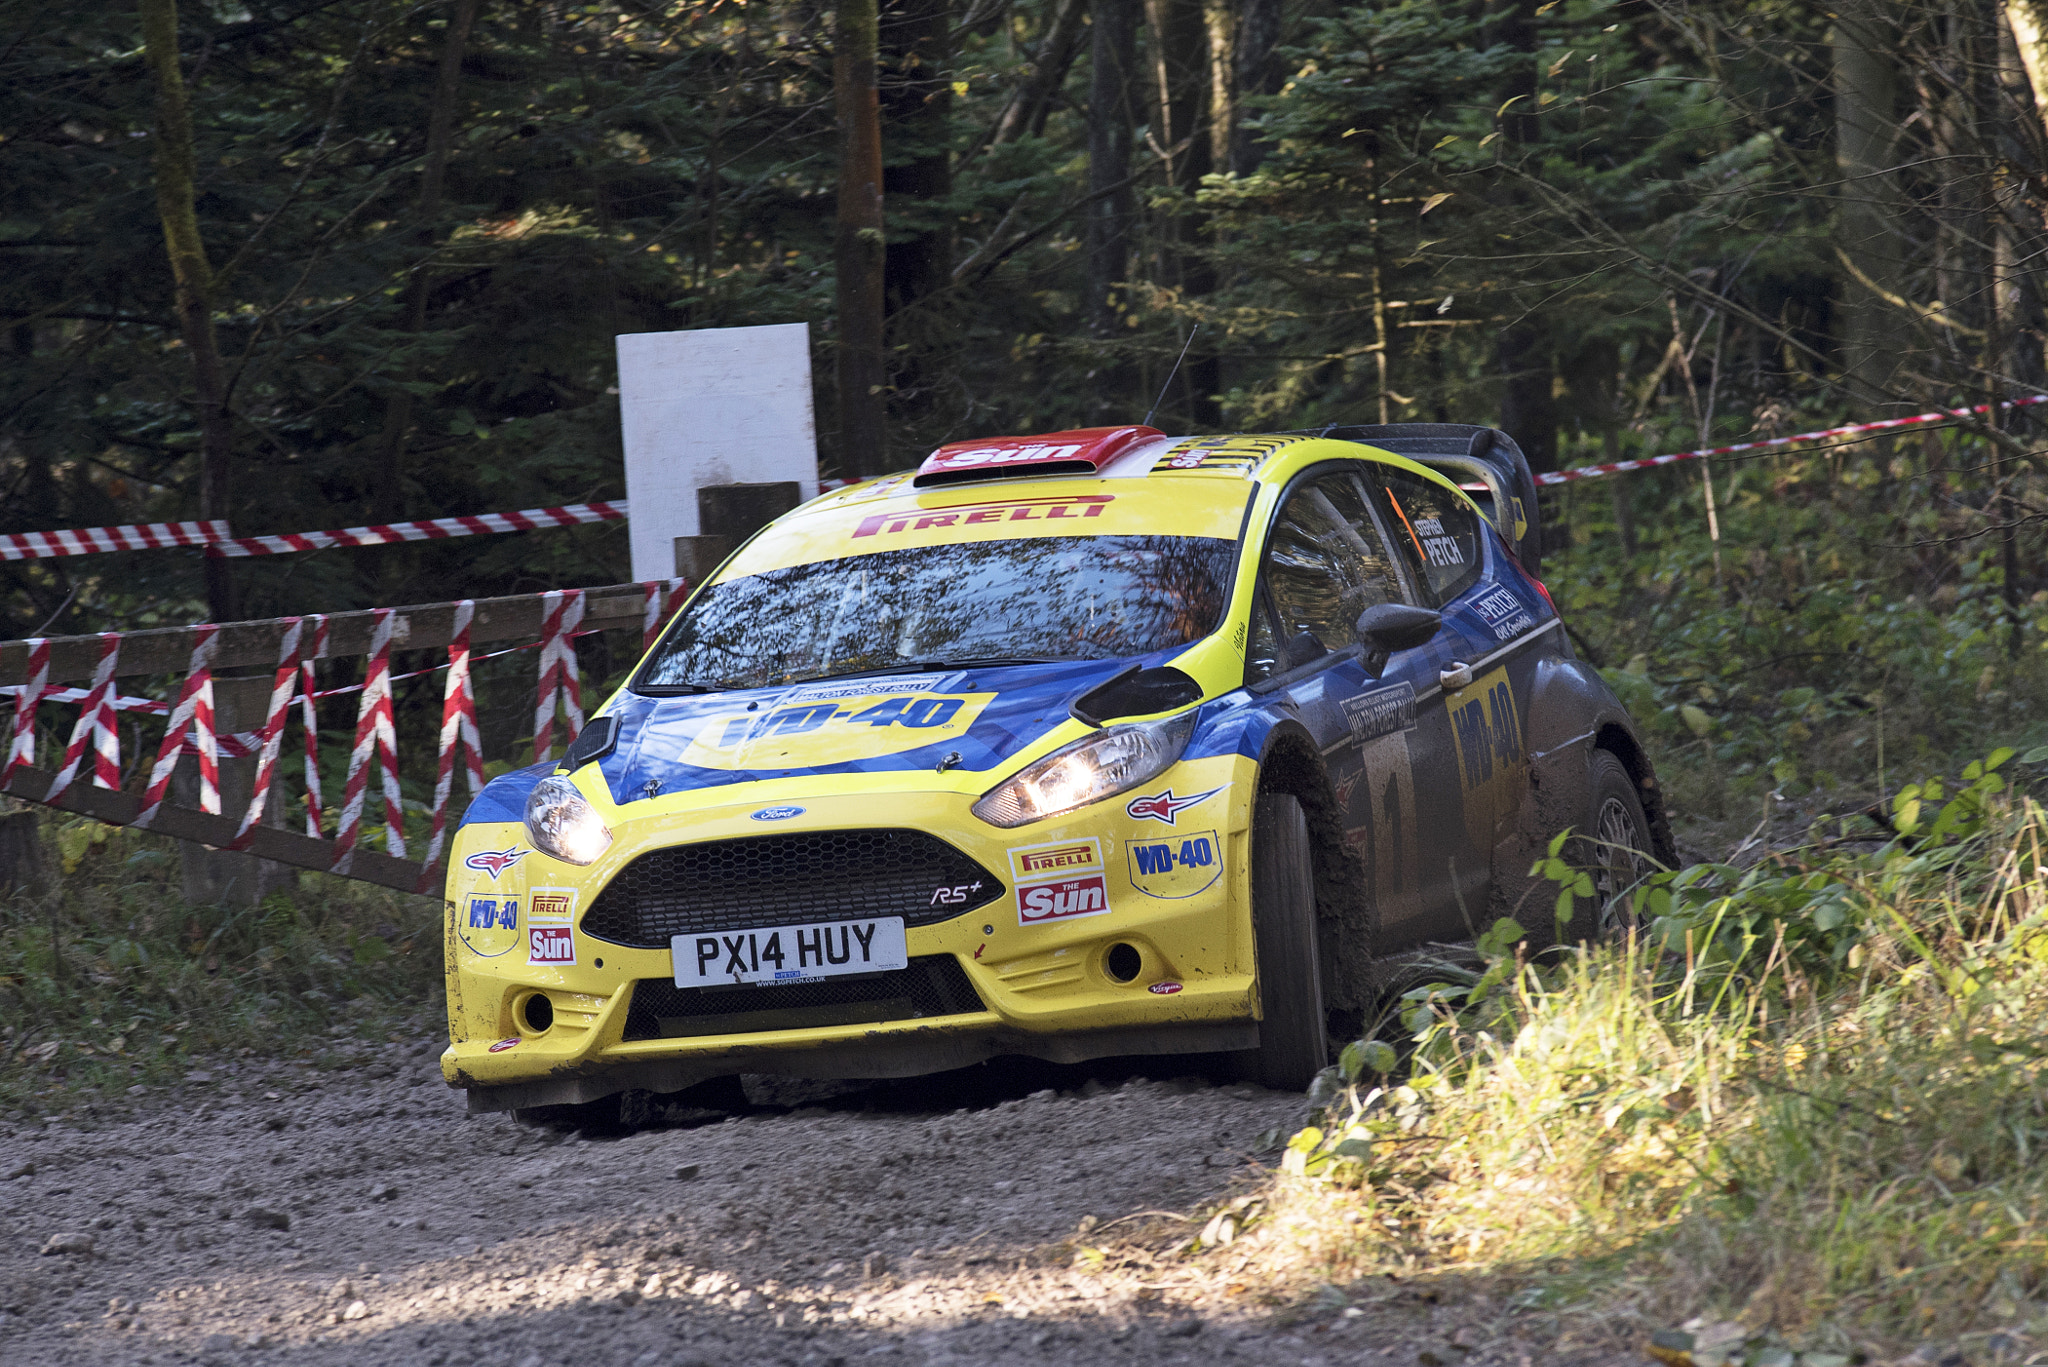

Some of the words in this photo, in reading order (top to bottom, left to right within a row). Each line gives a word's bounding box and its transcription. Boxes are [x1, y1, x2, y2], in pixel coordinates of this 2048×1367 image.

[942, 444, 1082, 467] Sun
[851, 495, 1115, 538] PIRELLI
[1414, 518, 1446, 537] STEPHEN
[1422, 535, 1464, 567] PETCH
[1478, 590, 1518, 618] PETCH
[718, 698, 966, 747] WD-40
[1452, 681, 1520, 791] WD-40
[761, 808, 796, 819] Ford
[1021, 846, 1092, 871] PIRELLI
[1134, 837, 1213, 875] WD-40
[1063, 882, 1080, 891] THE
[469, 899, 518, 930] WD-40
[532, 896, 569, 913] PIRELLI
[1023, 886, 1103, 918] Sun
[532, 931, 571, 959] Sun
[696, 931, 785, 976] PX14
[797, 923, 876, 967] HUY
